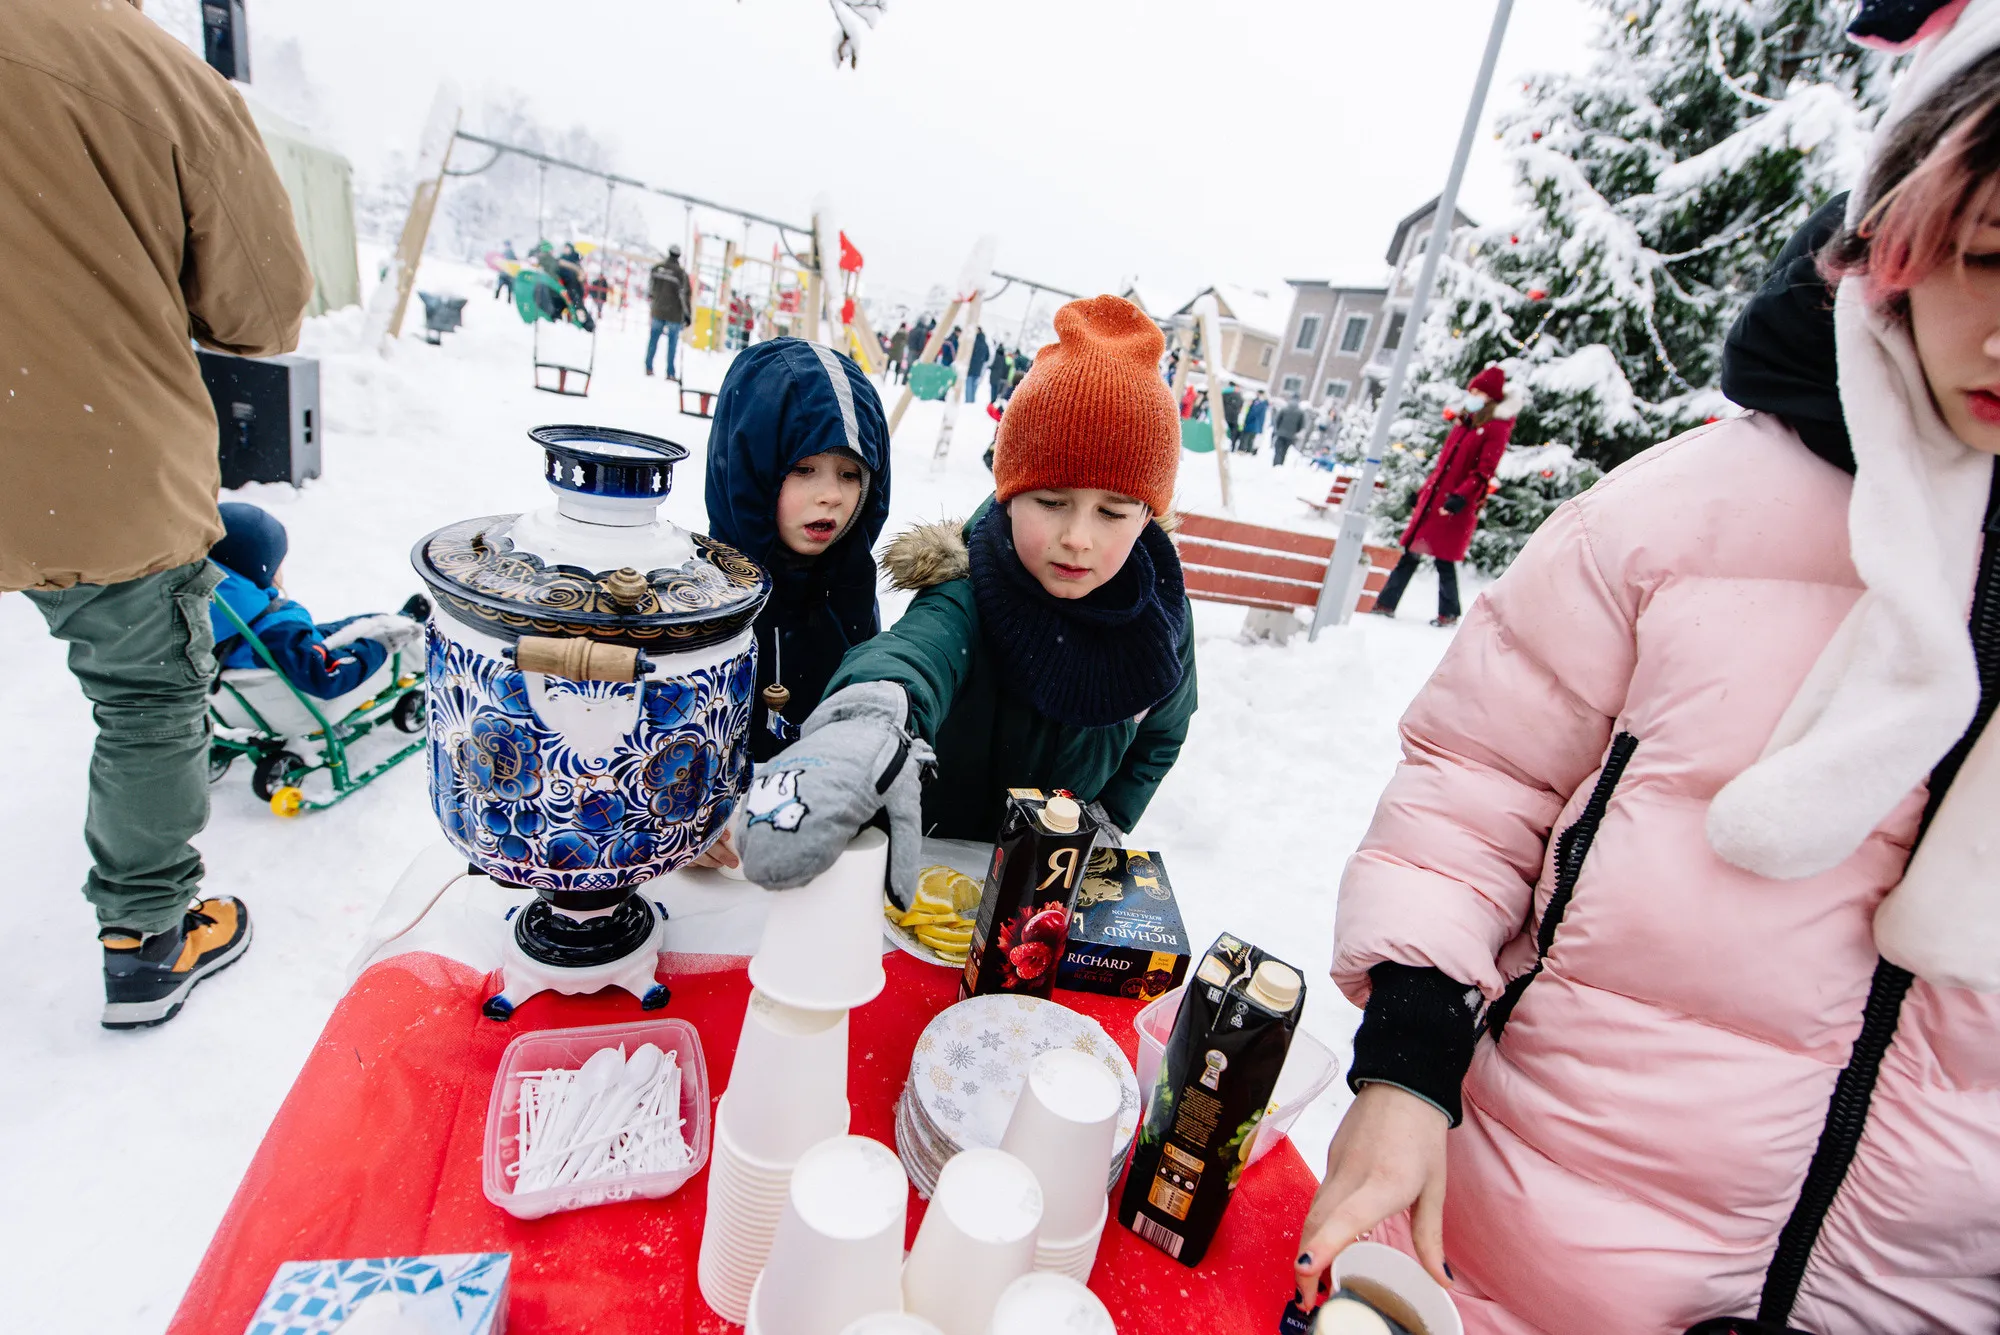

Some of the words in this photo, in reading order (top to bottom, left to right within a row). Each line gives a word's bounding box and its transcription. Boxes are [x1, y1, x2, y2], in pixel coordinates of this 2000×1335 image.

[1036, 848, 1080, 891] Я
[1112, 909, 1138, 918] CEYLON
[1140, 913, 1162, 921] ROYAL
[1105, 926, 1178, 945] RICHARD
[1067, 952, 1131, 971] RICHARD
[1099, 975, 1112, 983] TEA
